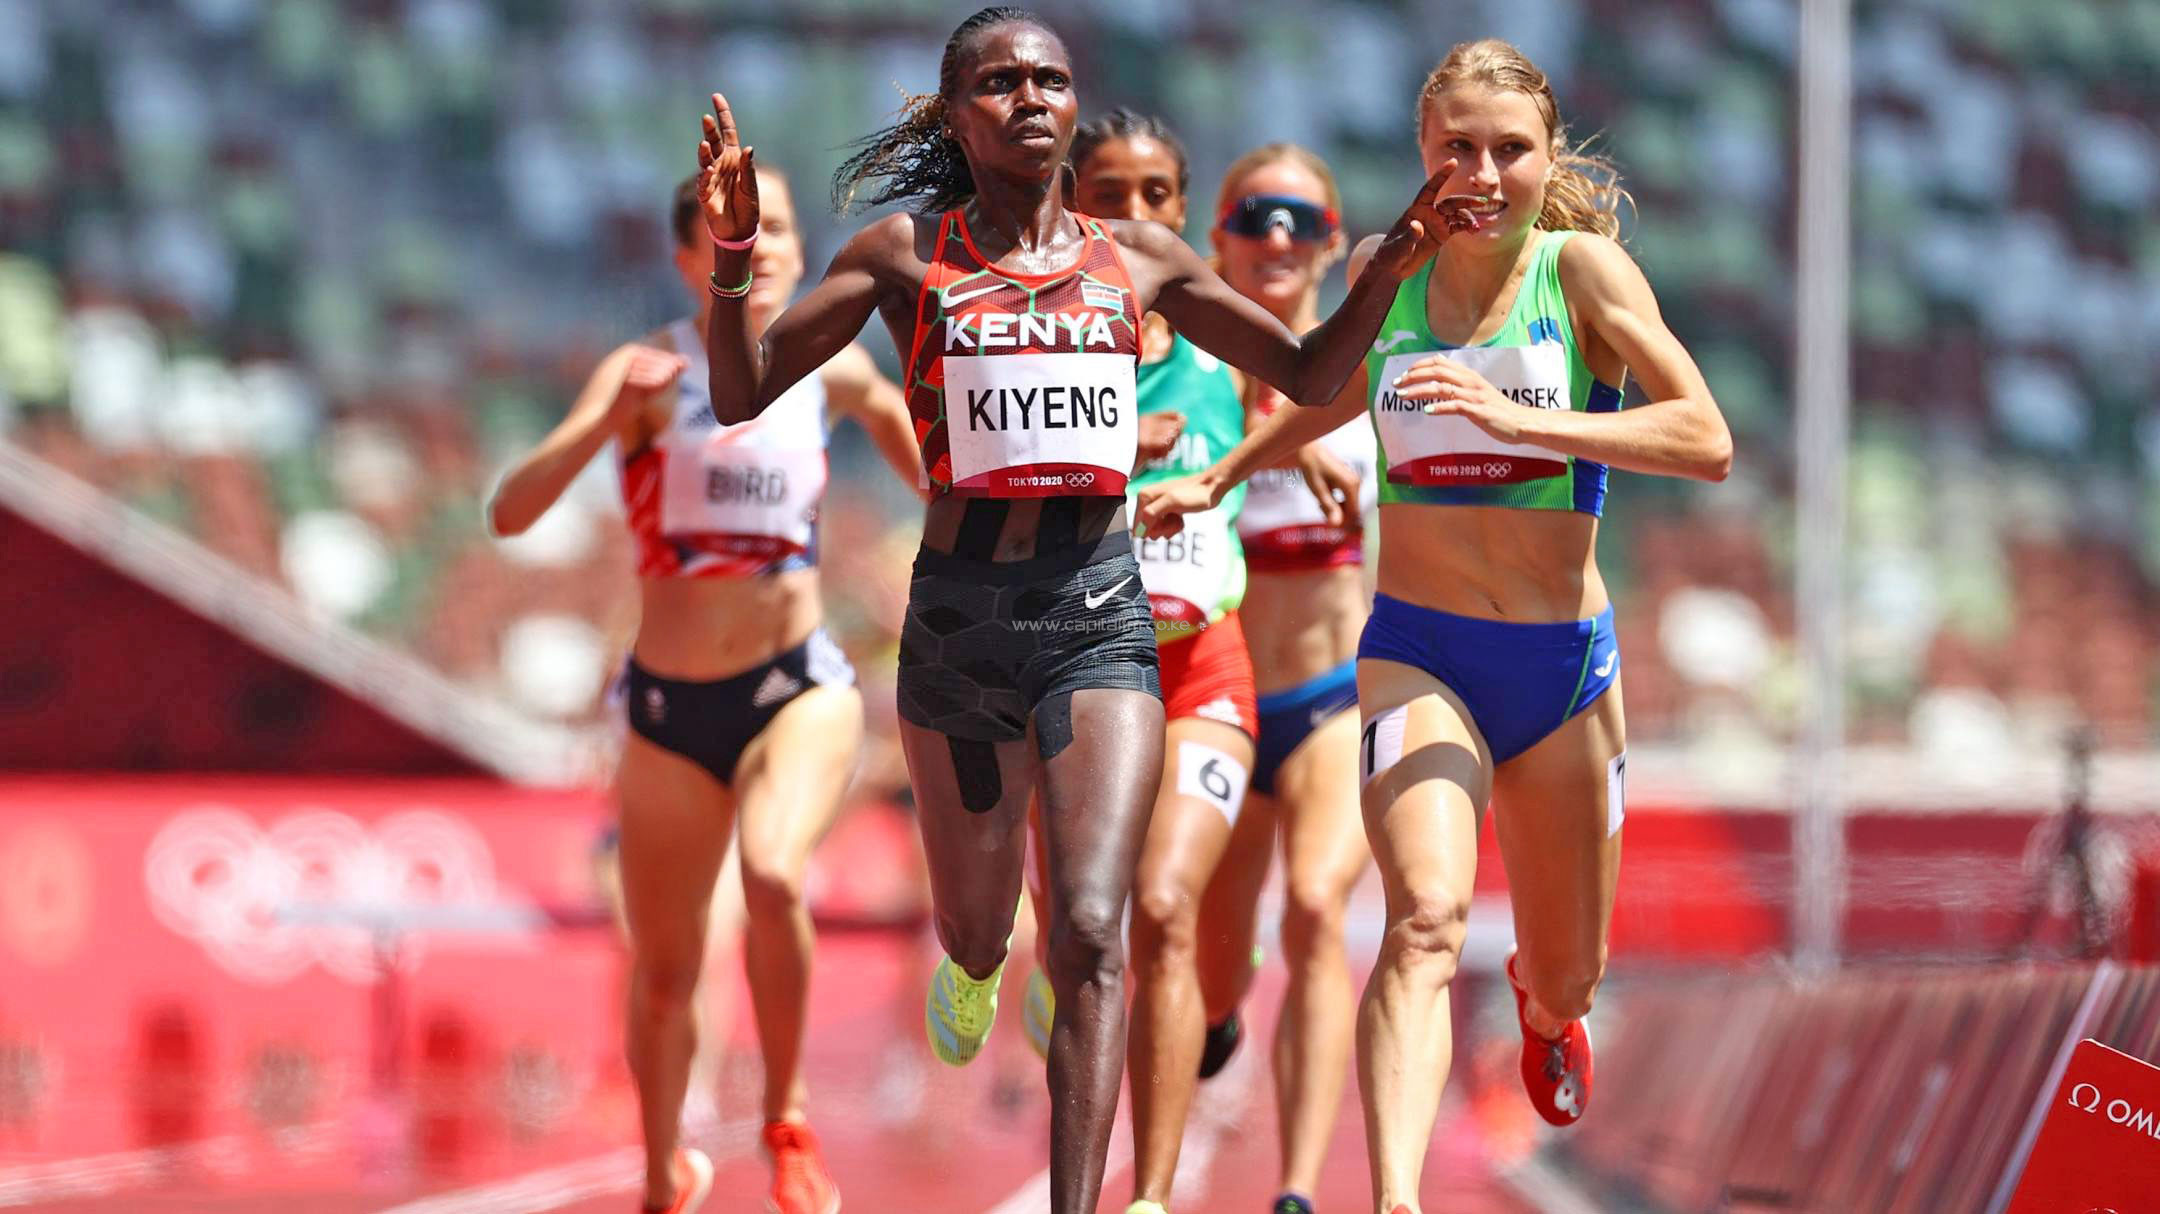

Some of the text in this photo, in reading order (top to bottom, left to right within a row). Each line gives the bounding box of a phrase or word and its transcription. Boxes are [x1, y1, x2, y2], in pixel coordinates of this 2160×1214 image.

[945, 312, 1115, 351] KENYA
[968, 386, 1117, 431] KIYENG
[707, 466, 787, 504] BIRD
[1008, 475, 1063, 487] TOKYO 2020
[1429, 465, 1481, 476] TOKYO 2020
[1140, 531, 1206, 567] EBE
[1361, 720, 1378, 778] 1
[1198, 758, 1231, 801] 6
